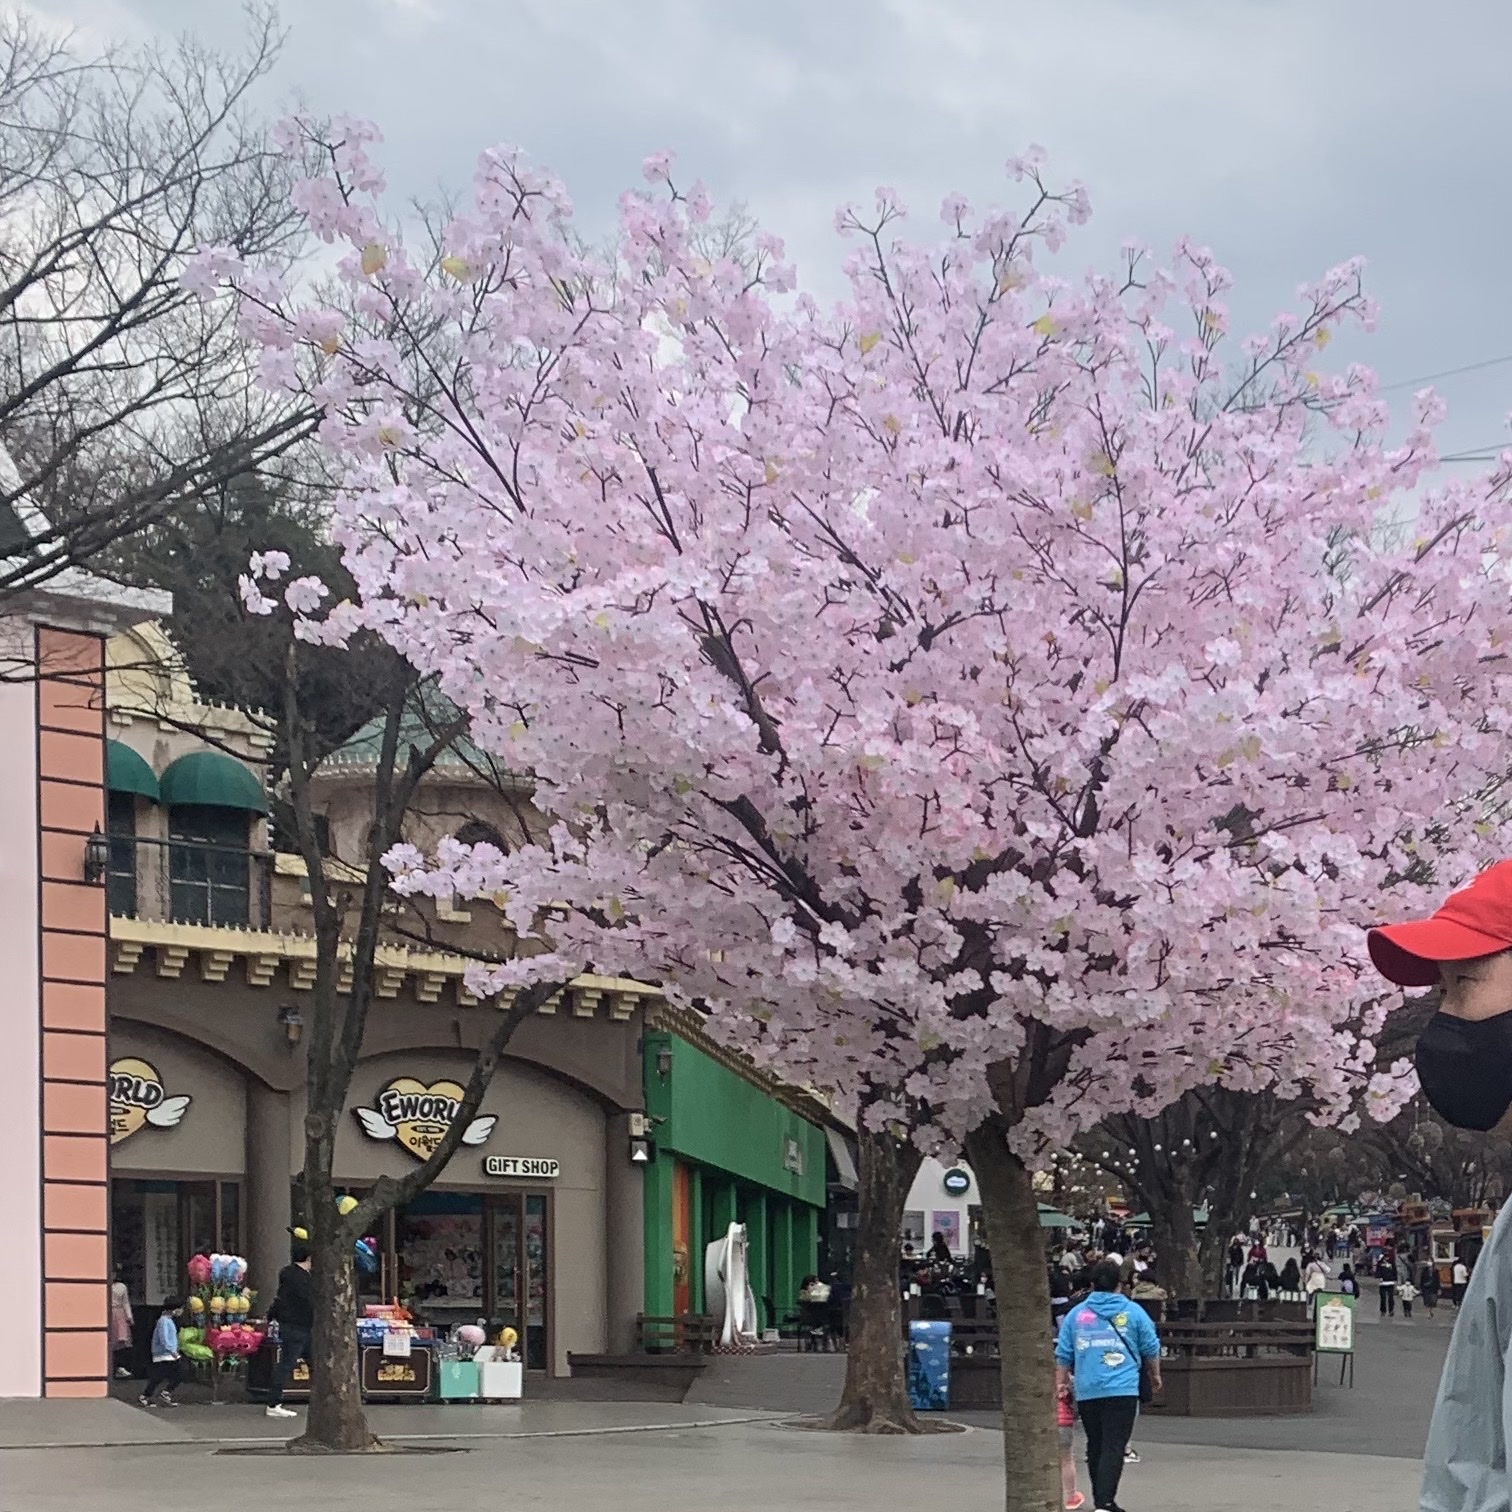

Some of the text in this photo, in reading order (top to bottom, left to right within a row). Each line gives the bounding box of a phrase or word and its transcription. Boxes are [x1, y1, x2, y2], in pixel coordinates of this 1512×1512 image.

[382, 1092, 459, 1121] EWORL
[488, 1158, 558, 1174] GIFT SHOP
